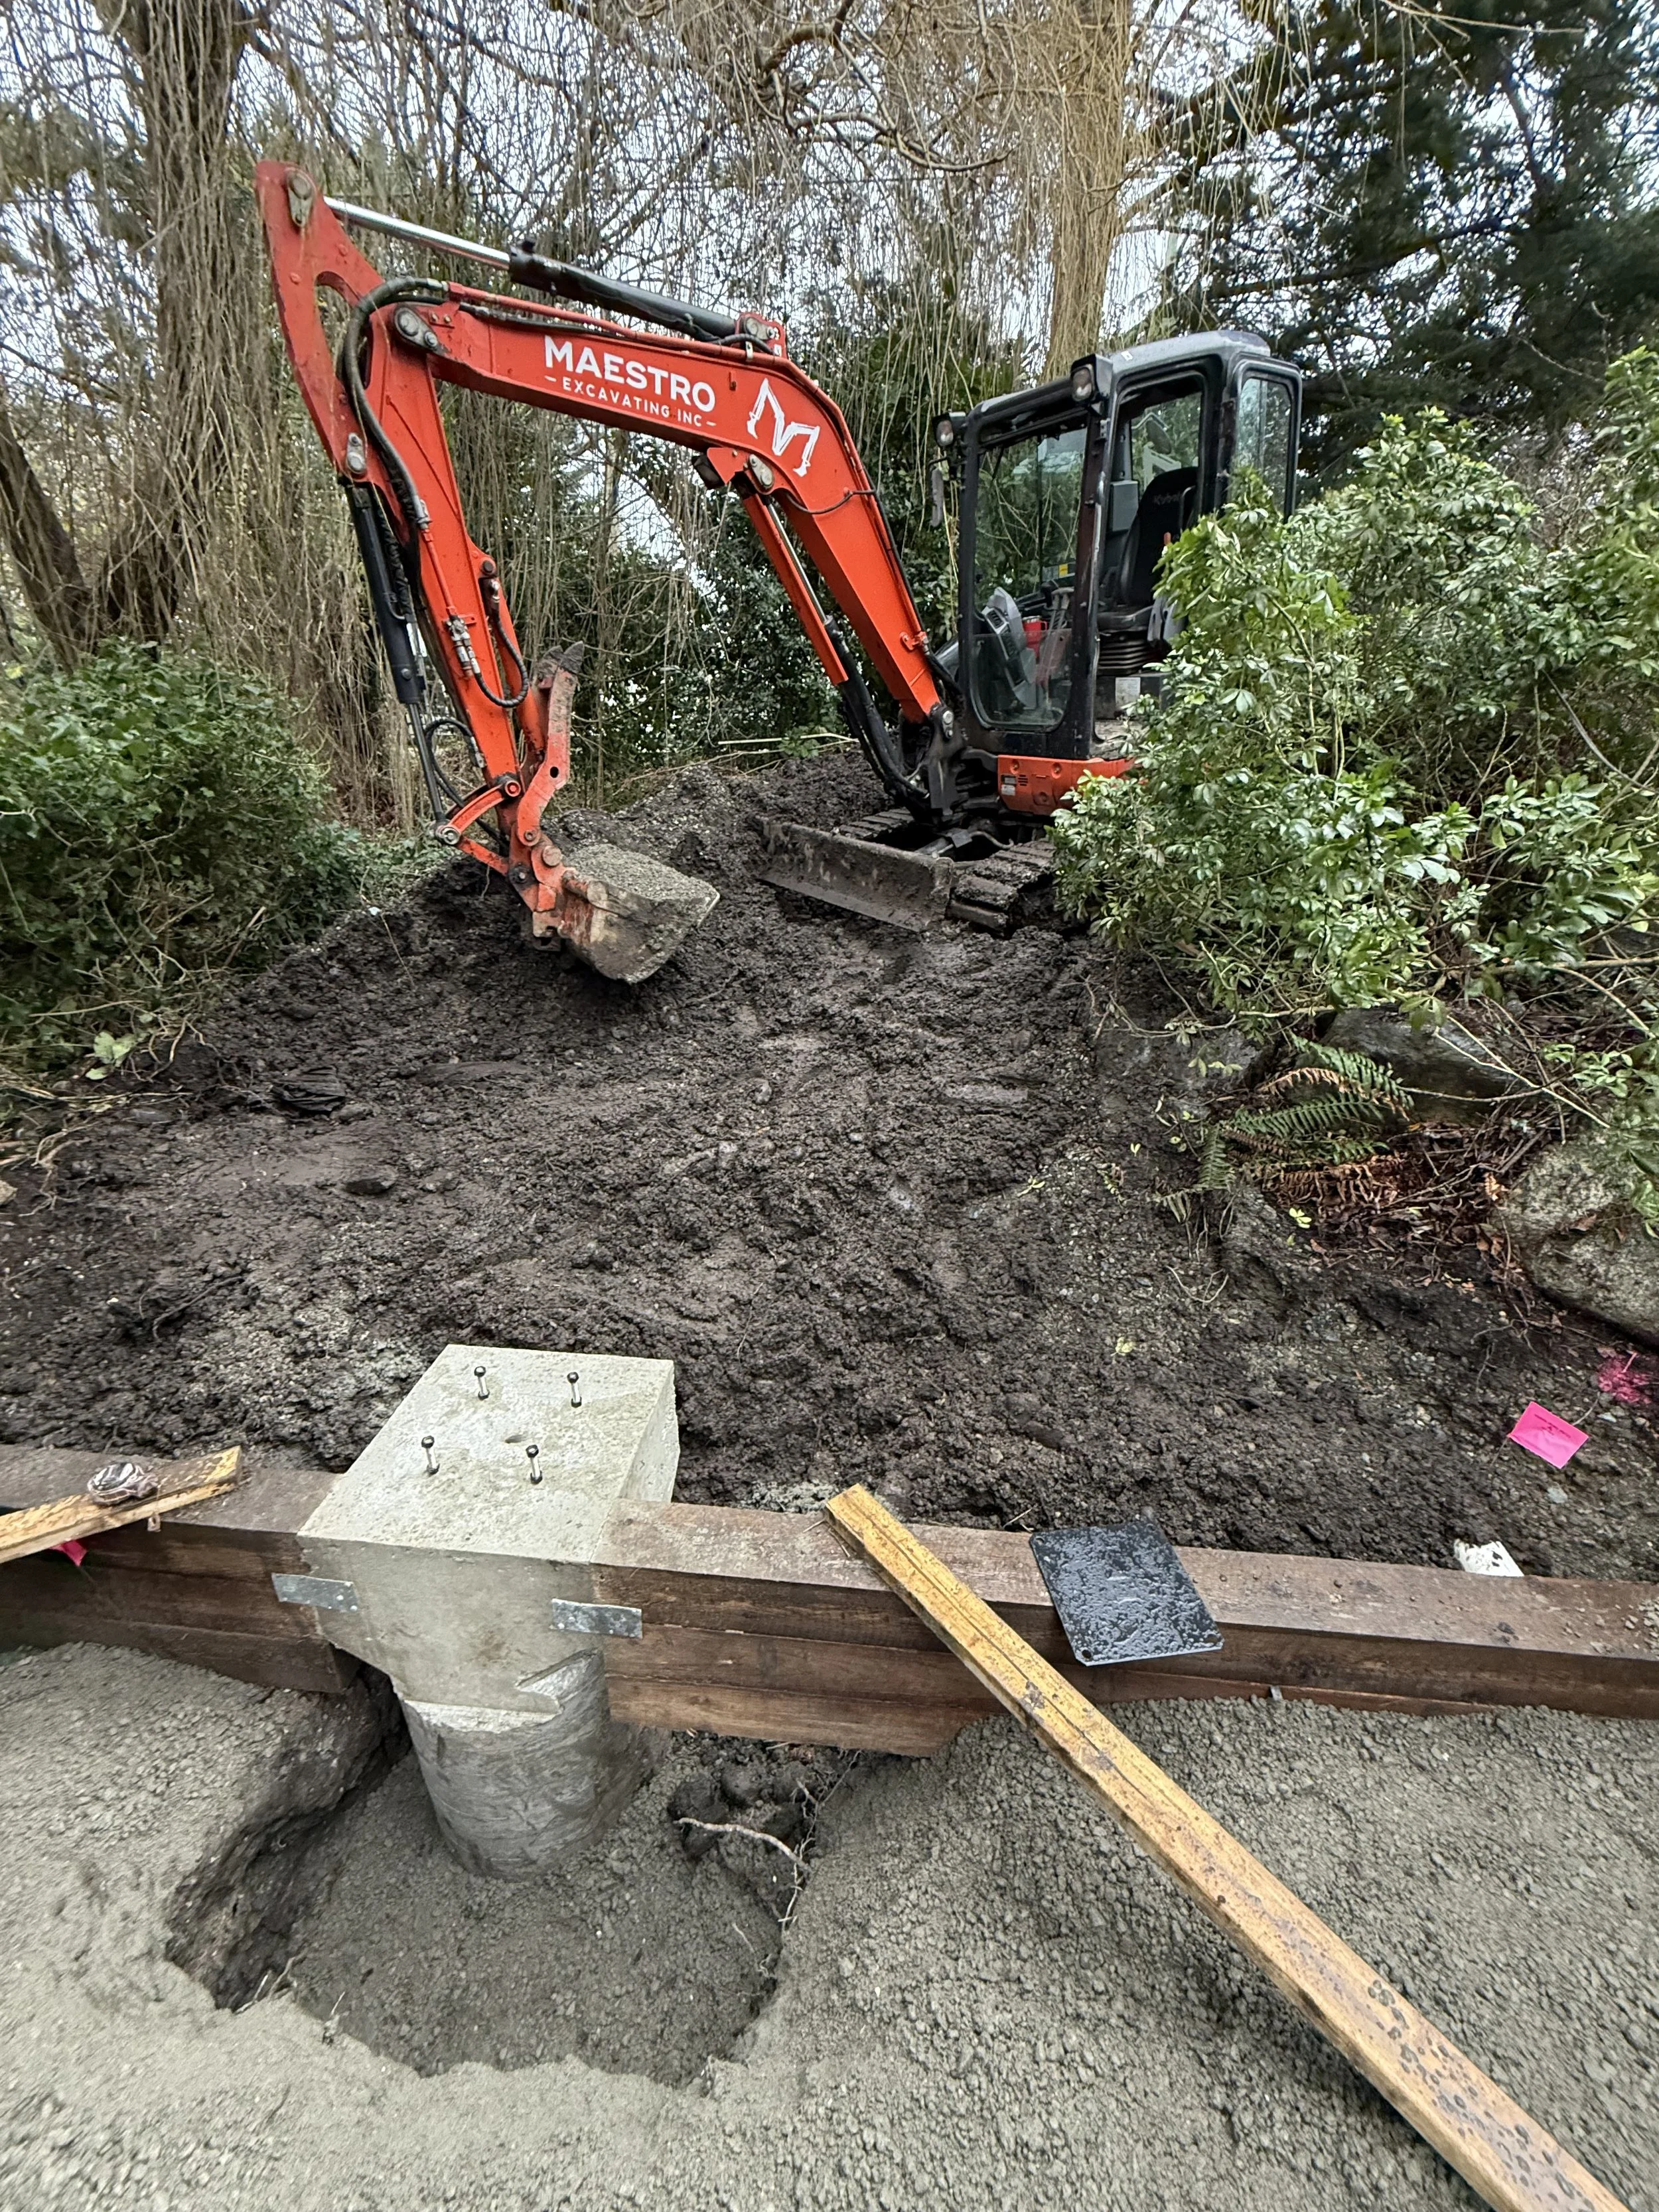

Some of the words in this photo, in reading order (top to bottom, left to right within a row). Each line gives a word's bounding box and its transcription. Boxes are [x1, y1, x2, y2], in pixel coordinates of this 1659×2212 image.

[545, 335, 716, 412] MAESTRO
[563, 376, 670, 418] EXCAVATING
[678, 409, 702, 427] INC
